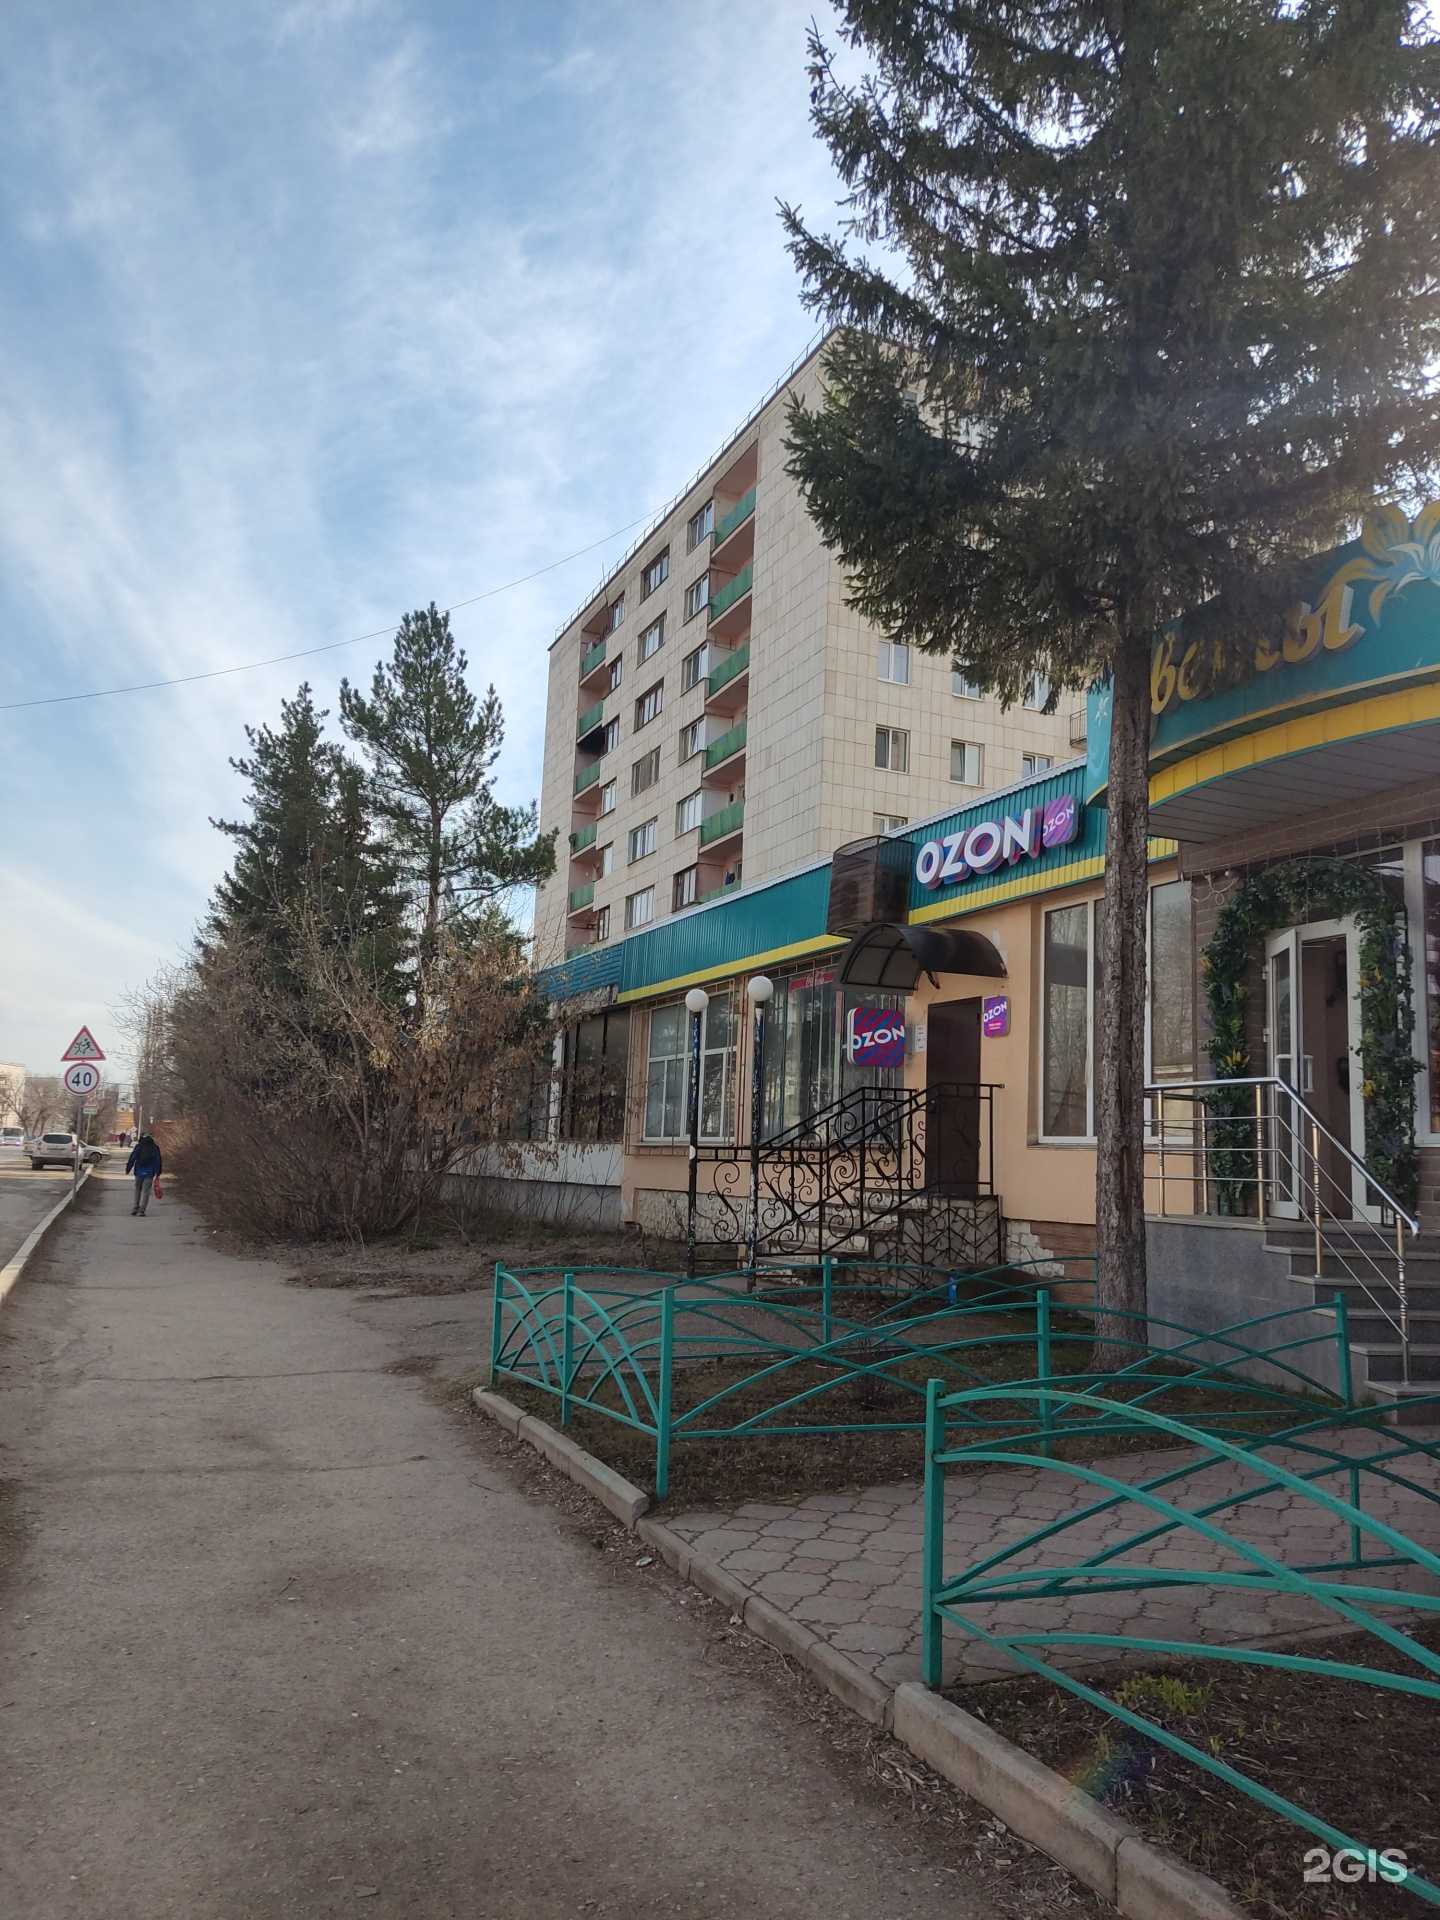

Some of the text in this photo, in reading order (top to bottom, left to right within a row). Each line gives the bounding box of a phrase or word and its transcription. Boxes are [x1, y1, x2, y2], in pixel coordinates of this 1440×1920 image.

[916, 808, 1032, 885] OZON
[852, 1025, 905, 1051] OZON
[71, 1071, 92, 1087] 40
